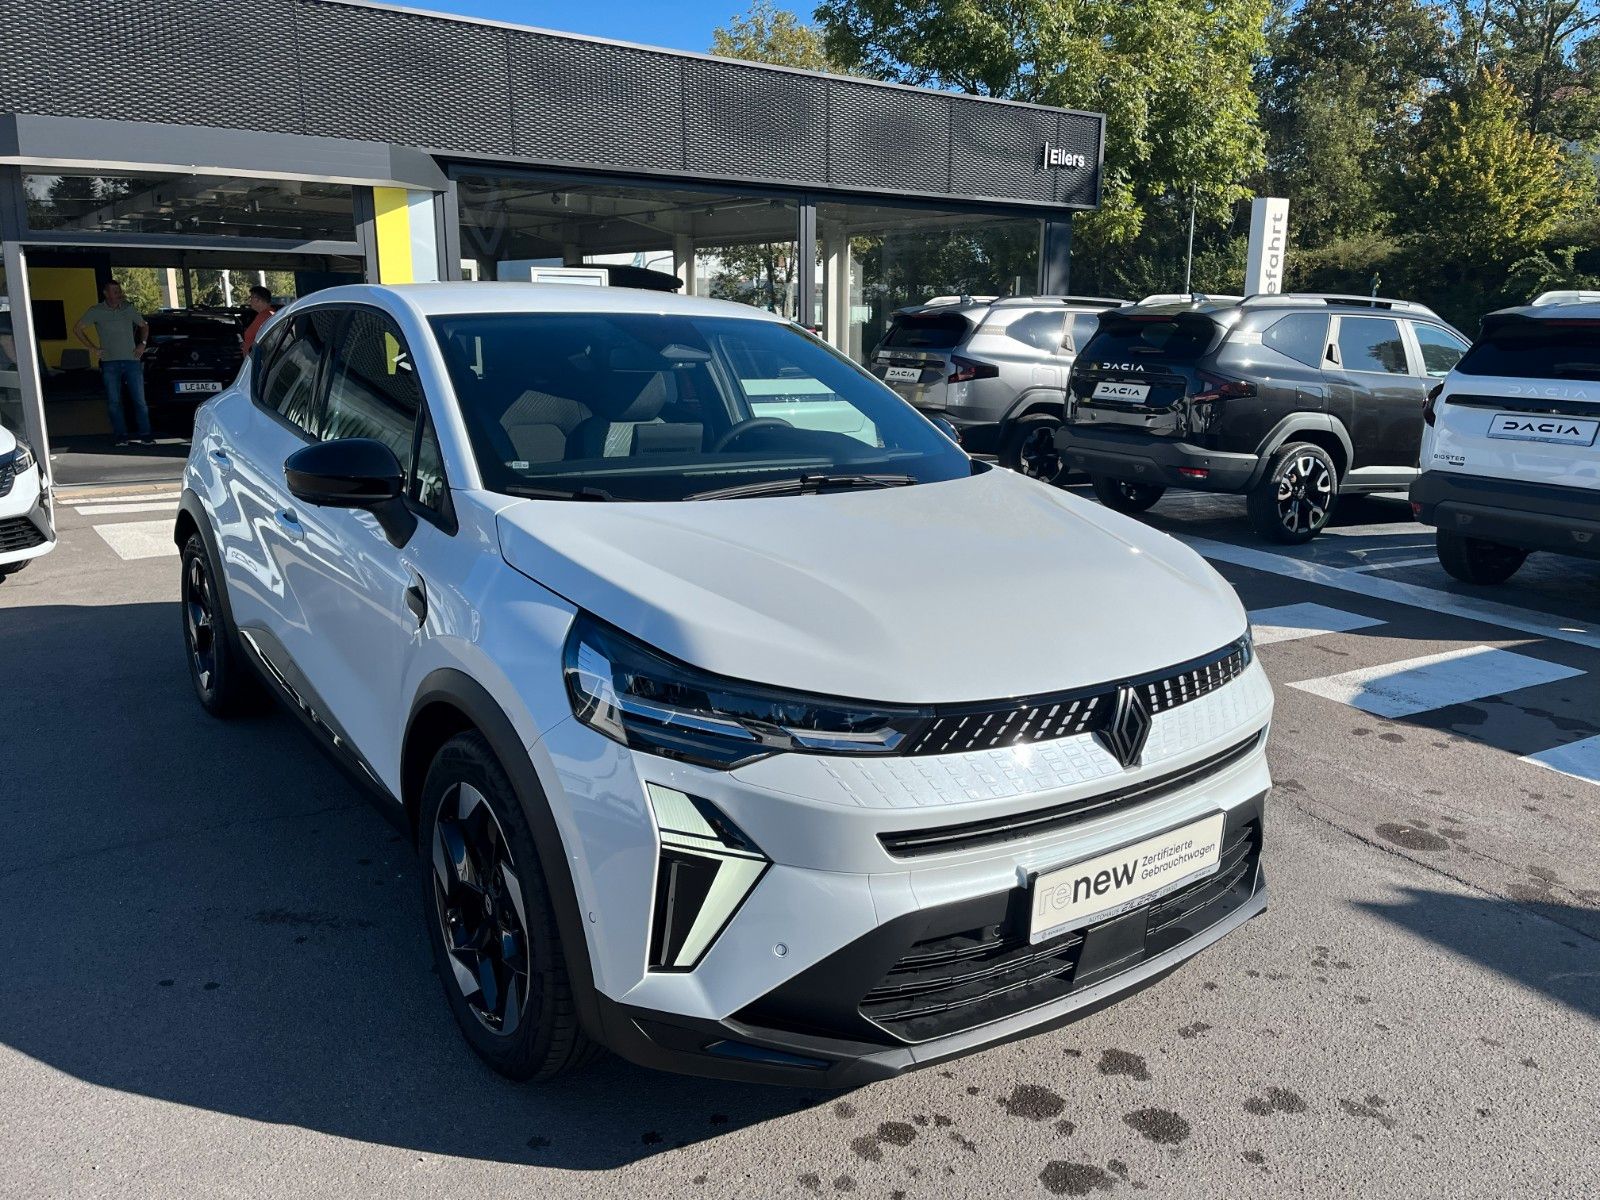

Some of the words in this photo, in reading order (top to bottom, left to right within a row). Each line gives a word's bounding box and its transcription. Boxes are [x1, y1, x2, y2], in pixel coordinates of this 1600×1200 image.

[1050, 148, 1085, 168] Eilers
[890, 370, 916, 378] DACIA
[1102, 362, 1145, 372] DACIA
[1101, 386, 1140, 396] DACIA
[1507, 384, 1588, 399] DACIA
[1502, 421, 1580, 436] DACIA
[1141, 843, 1215, 880] Gebrauchtwagen
[1142, 840, 1193, 868] Zertifizierte
